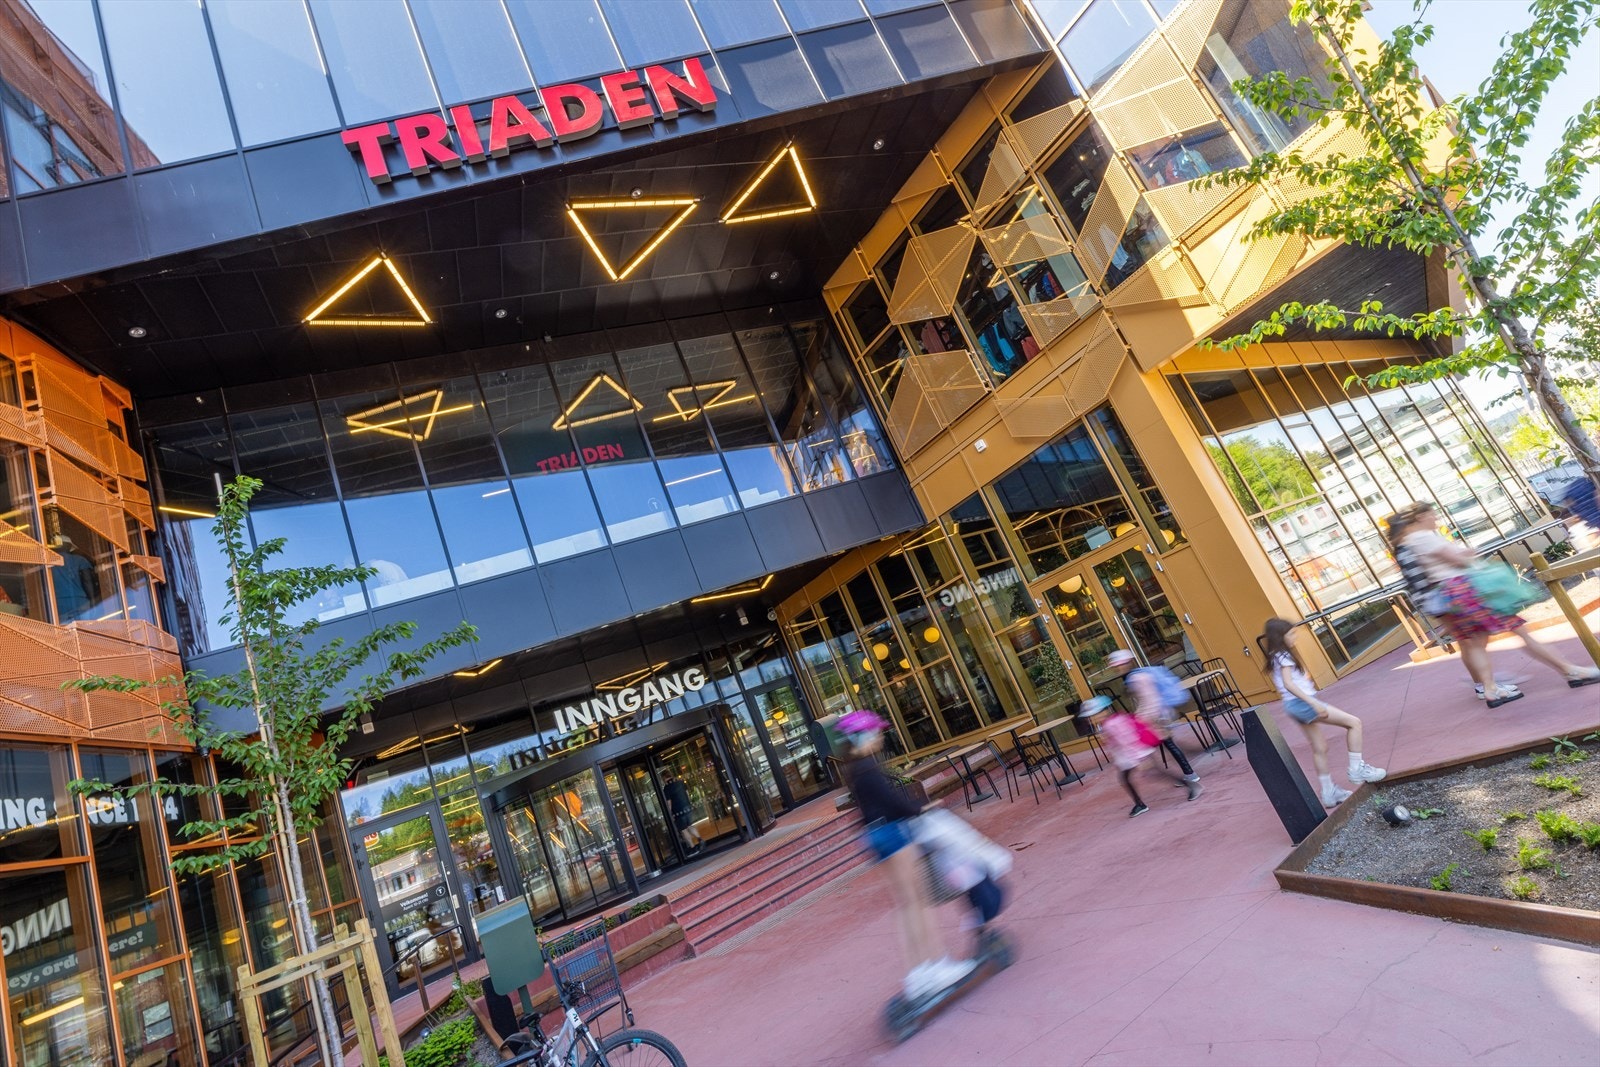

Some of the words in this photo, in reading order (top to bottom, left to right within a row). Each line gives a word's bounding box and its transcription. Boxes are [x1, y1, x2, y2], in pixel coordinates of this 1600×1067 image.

[341, 58, 718, 184] TRIADEN
[554, 668, 706, 734] INNGANG
[8, 974, 40, 988] ey,
[108, 931, 144, 953] ere!
